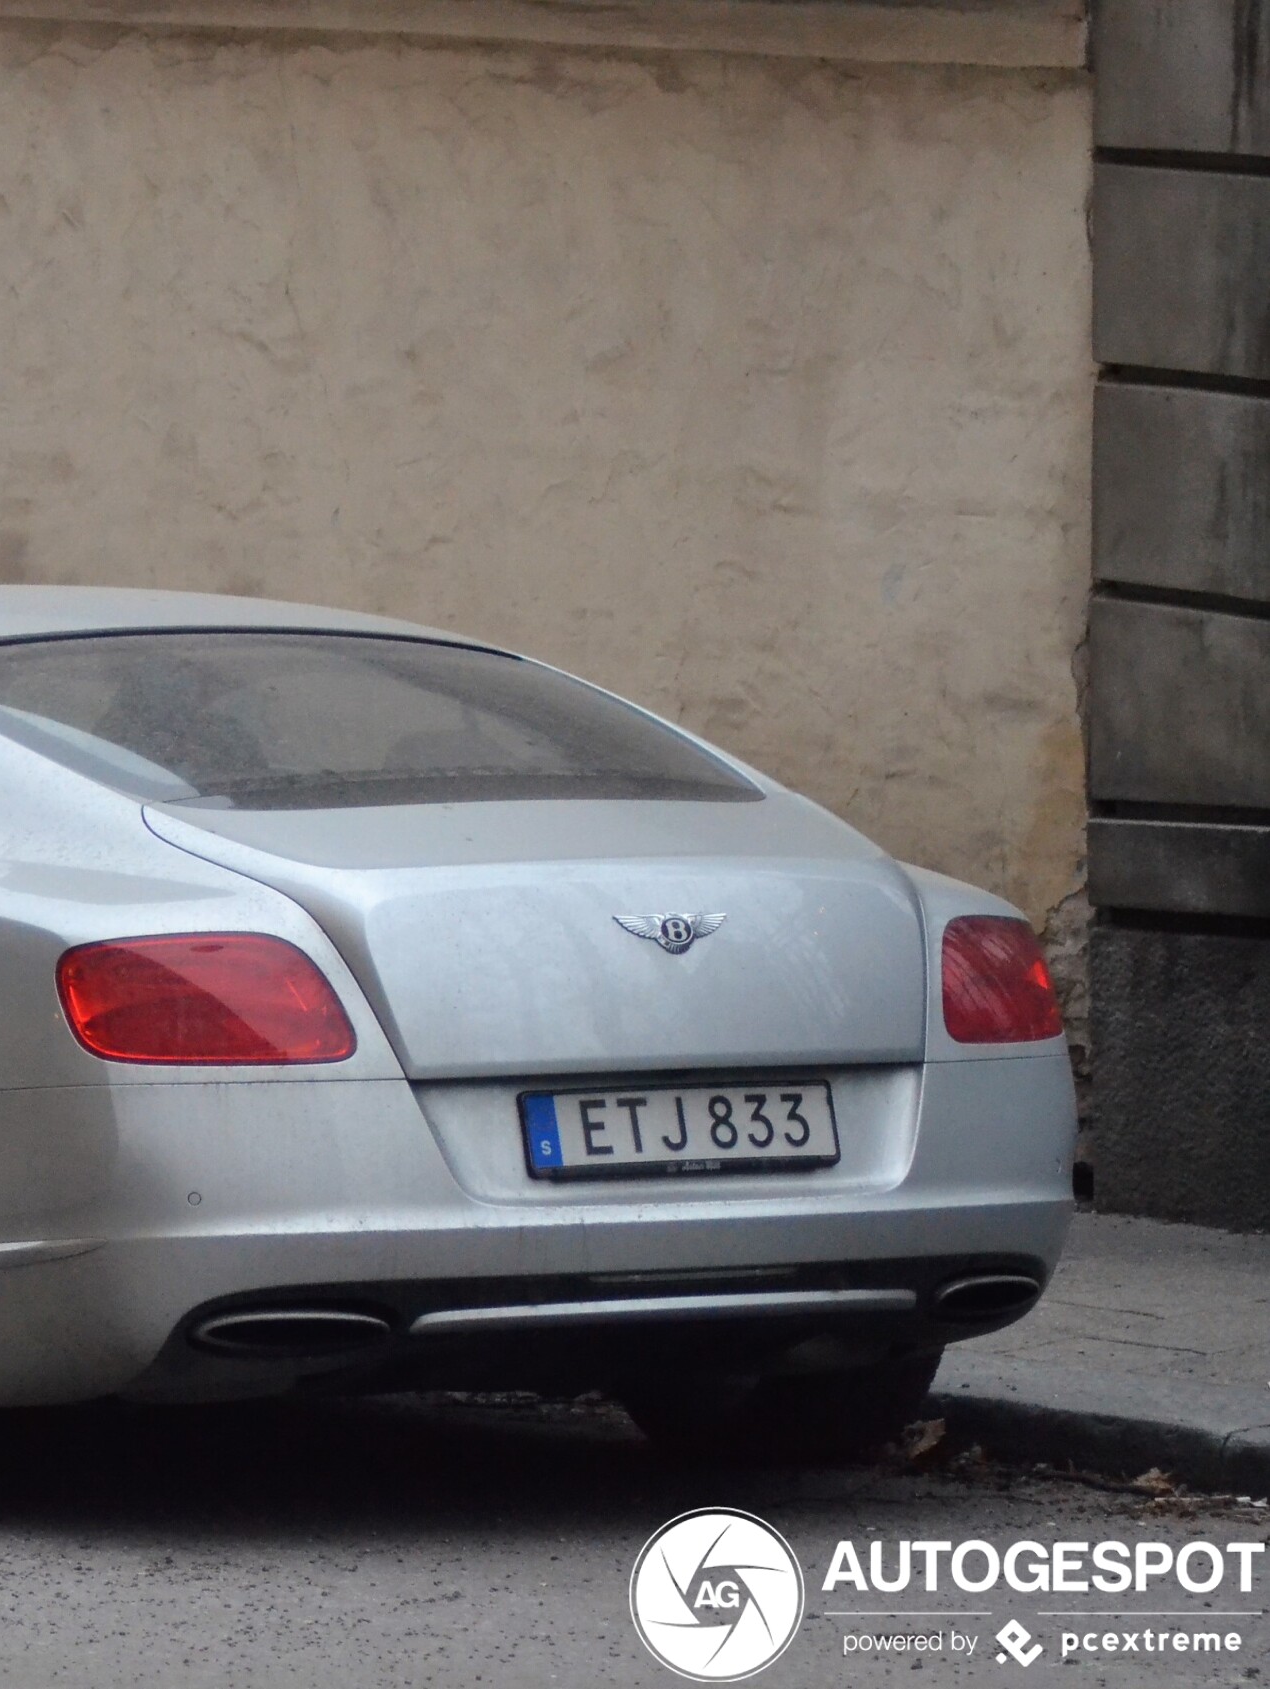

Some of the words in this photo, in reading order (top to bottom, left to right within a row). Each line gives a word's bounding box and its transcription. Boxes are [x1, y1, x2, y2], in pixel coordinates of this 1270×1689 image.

[666, 920, 688, 941] B
[579, 1096, 688, 1156] ETJ
[708, 1093, 810, 1149] 833
[541, 1140, 552, 1156] S
